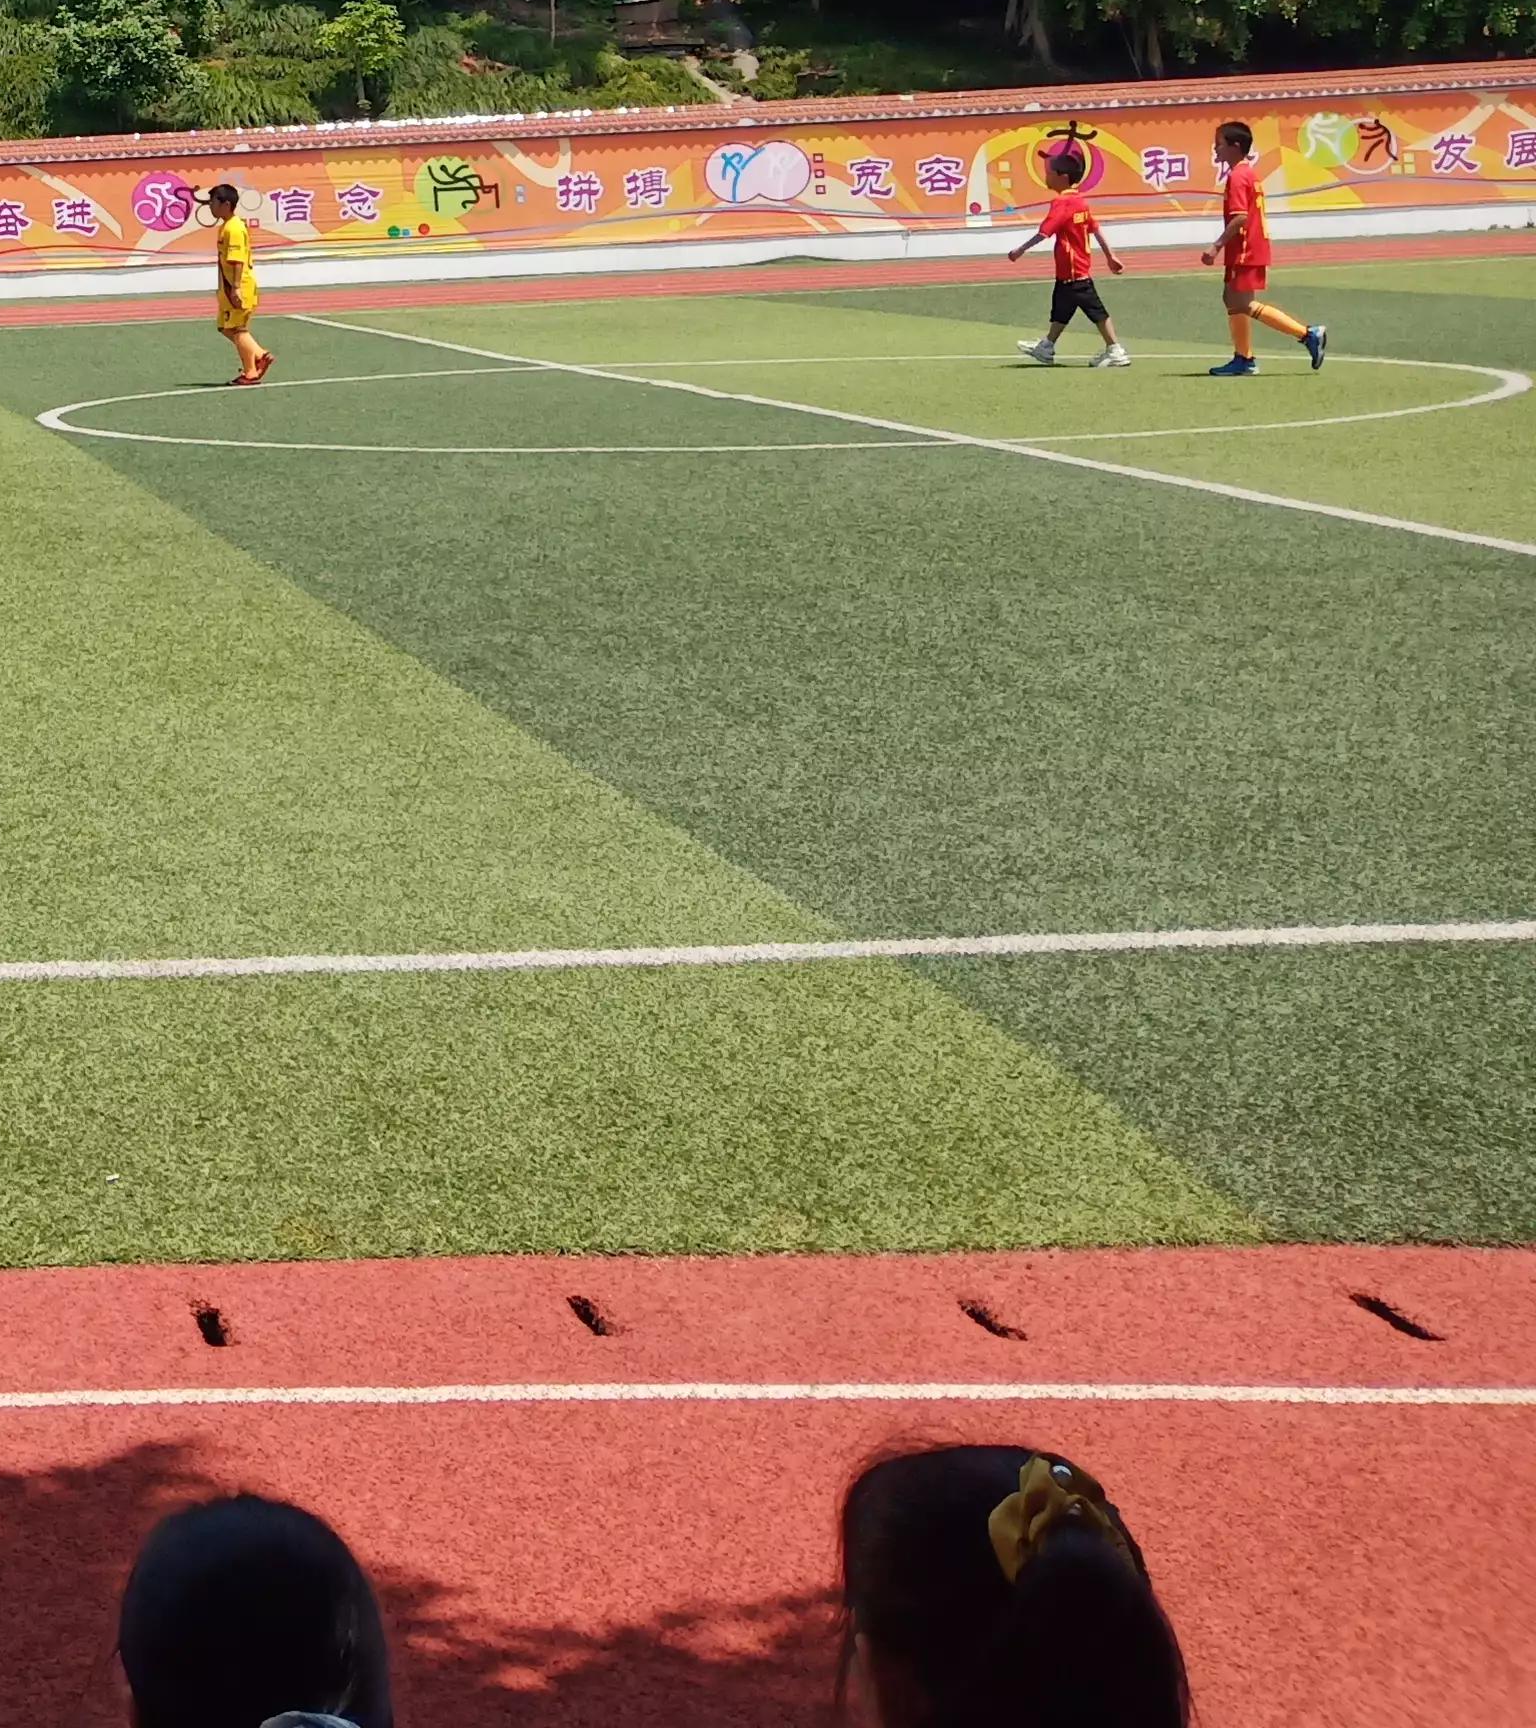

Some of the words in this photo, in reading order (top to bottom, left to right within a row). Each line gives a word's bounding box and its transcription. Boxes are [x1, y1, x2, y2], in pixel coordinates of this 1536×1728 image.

[556, 168, 671, 212] 拼搏
[848, 156, 965, 198] 宽容
[269, 183, 381, 222] 信念
